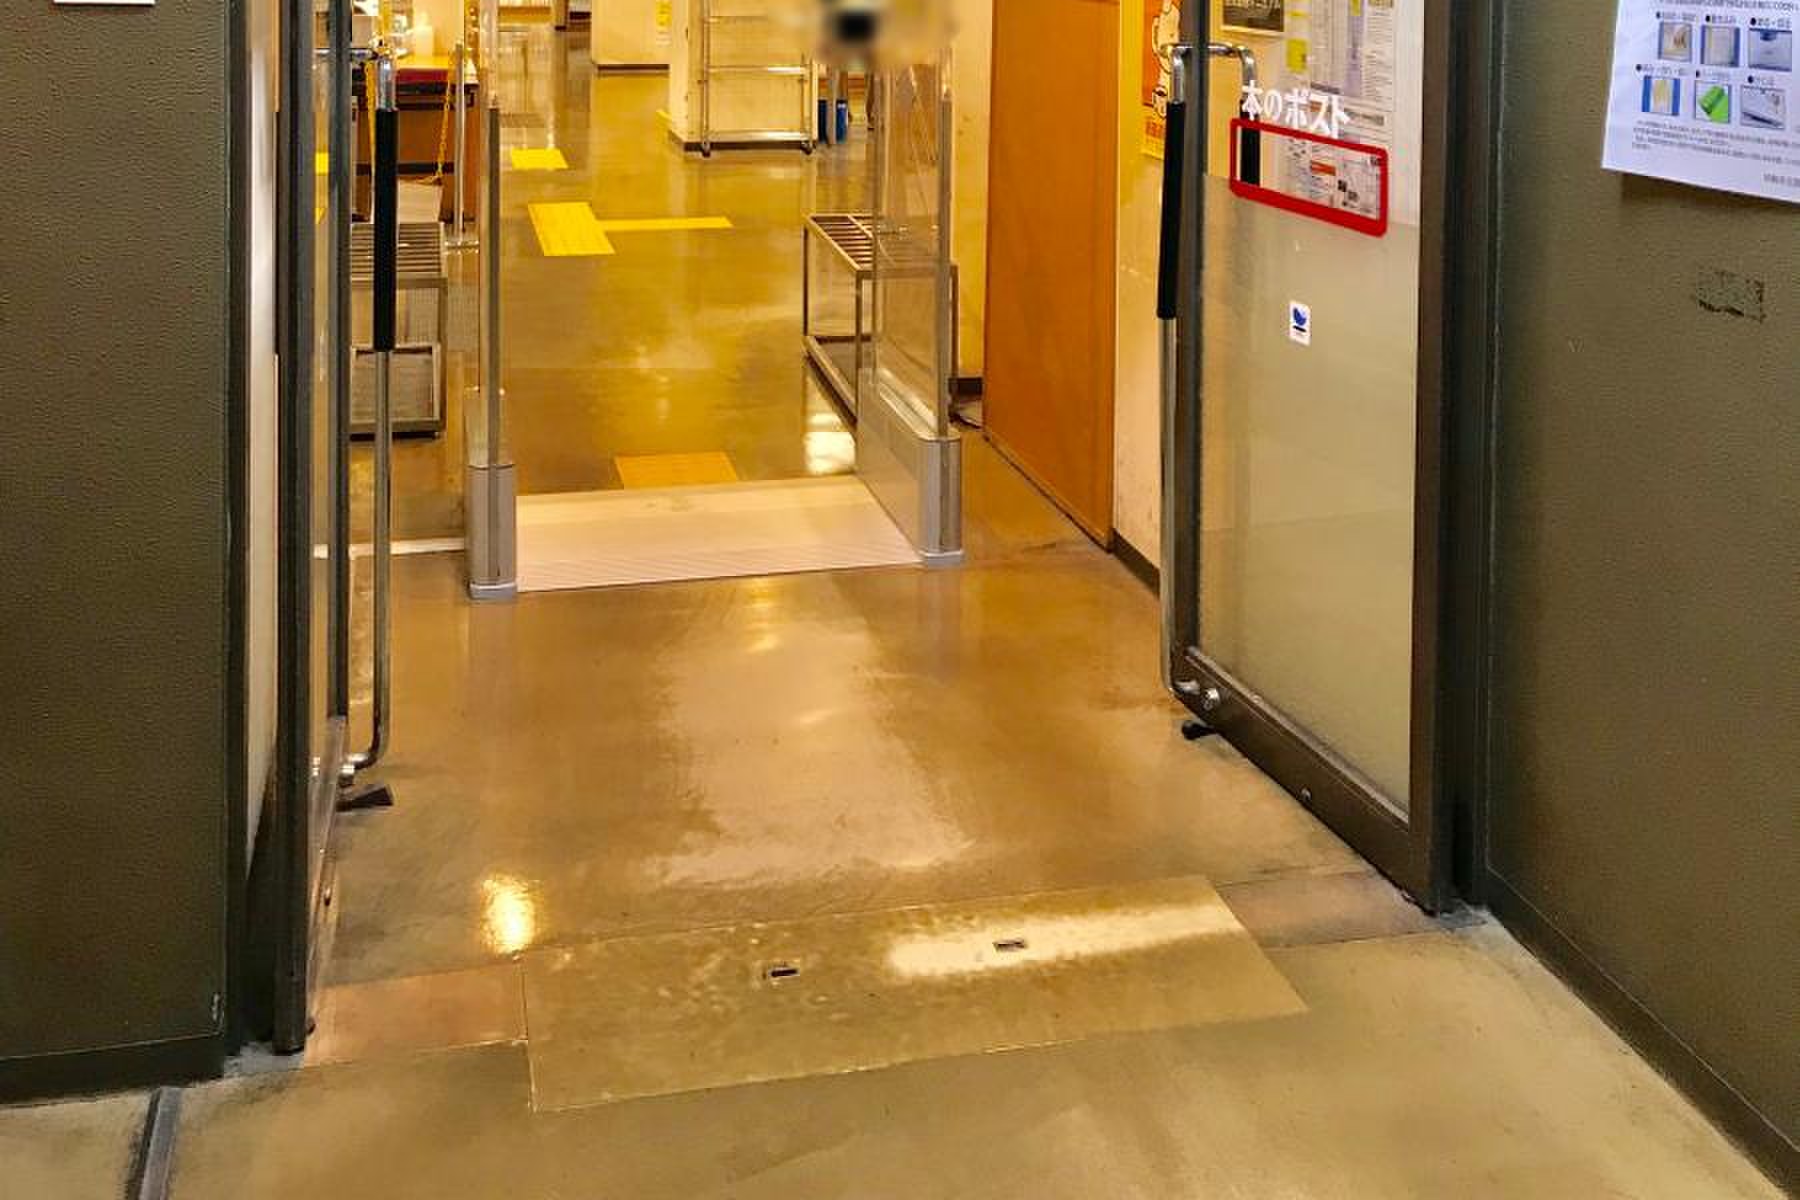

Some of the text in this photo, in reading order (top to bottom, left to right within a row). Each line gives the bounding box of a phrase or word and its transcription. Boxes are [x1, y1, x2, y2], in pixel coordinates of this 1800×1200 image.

[1242, 79, 1351, 140] 本のポスト
